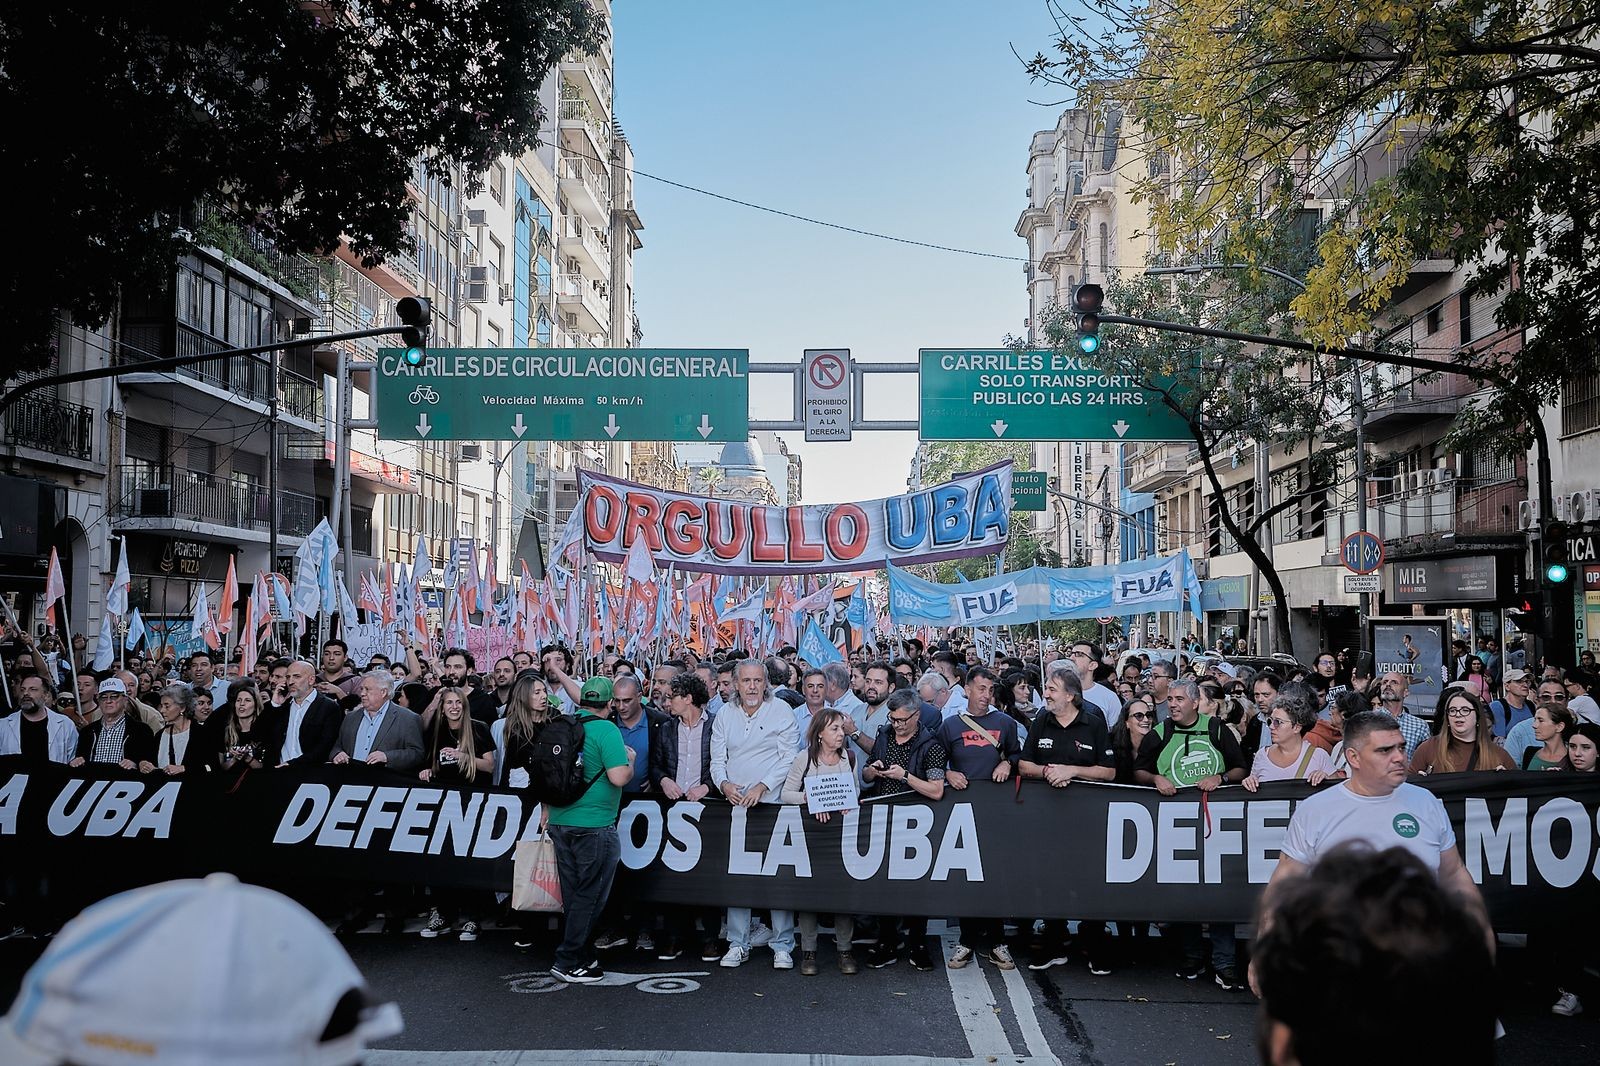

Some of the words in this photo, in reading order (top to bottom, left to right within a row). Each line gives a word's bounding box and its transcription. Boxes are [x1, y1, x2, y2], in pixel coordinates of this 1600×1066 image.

[483, 356, 509, 377] DE
[512, 356, 646, 377] CIRCULACION
[650, 357, 745, 378] GENERAL
[940, 354, 1044, 371] CARRILES
[979, 374, 1025, 388] SOLO
[1030, 374, 1142, 388] TRANSPORTE
[482, 395, 537, 405] Velocidad
[543, 395, 584, 405] Máxima
[596, 396, 608, 405] 50
[612, 395, 643, 405] km/h
[973, 391, 1044, 405] PUBLICO
[1050, 391, 1082, 405] LAS
[1086, 391, 1105, 405] 24
[1109, 391, 1148, 405] HRS.
[812, 408, 823, 416] EL
[586, 484, 869, 562] ORGULLO
[886, 474, 1008, 550] UBA
[1399, 567, 1427, 584] MIR
[1121, 569, 1174, 598] FUA
[961, 588, 1015, 619] FUA
[1377, 662, 1416, 673] VELOCITY
[1416, 663, 1422, 673] 3
[1182, 766, 1213, 779] APUBA
[810, 788, 845, 798] UNIVERSIDAD
[818, 794, 848, 802] EDUCACIÓN
[47, 778, 183, 839] UBA
[728, 804, 813, 878] LA
[841, 802, 985, 882] UBA
